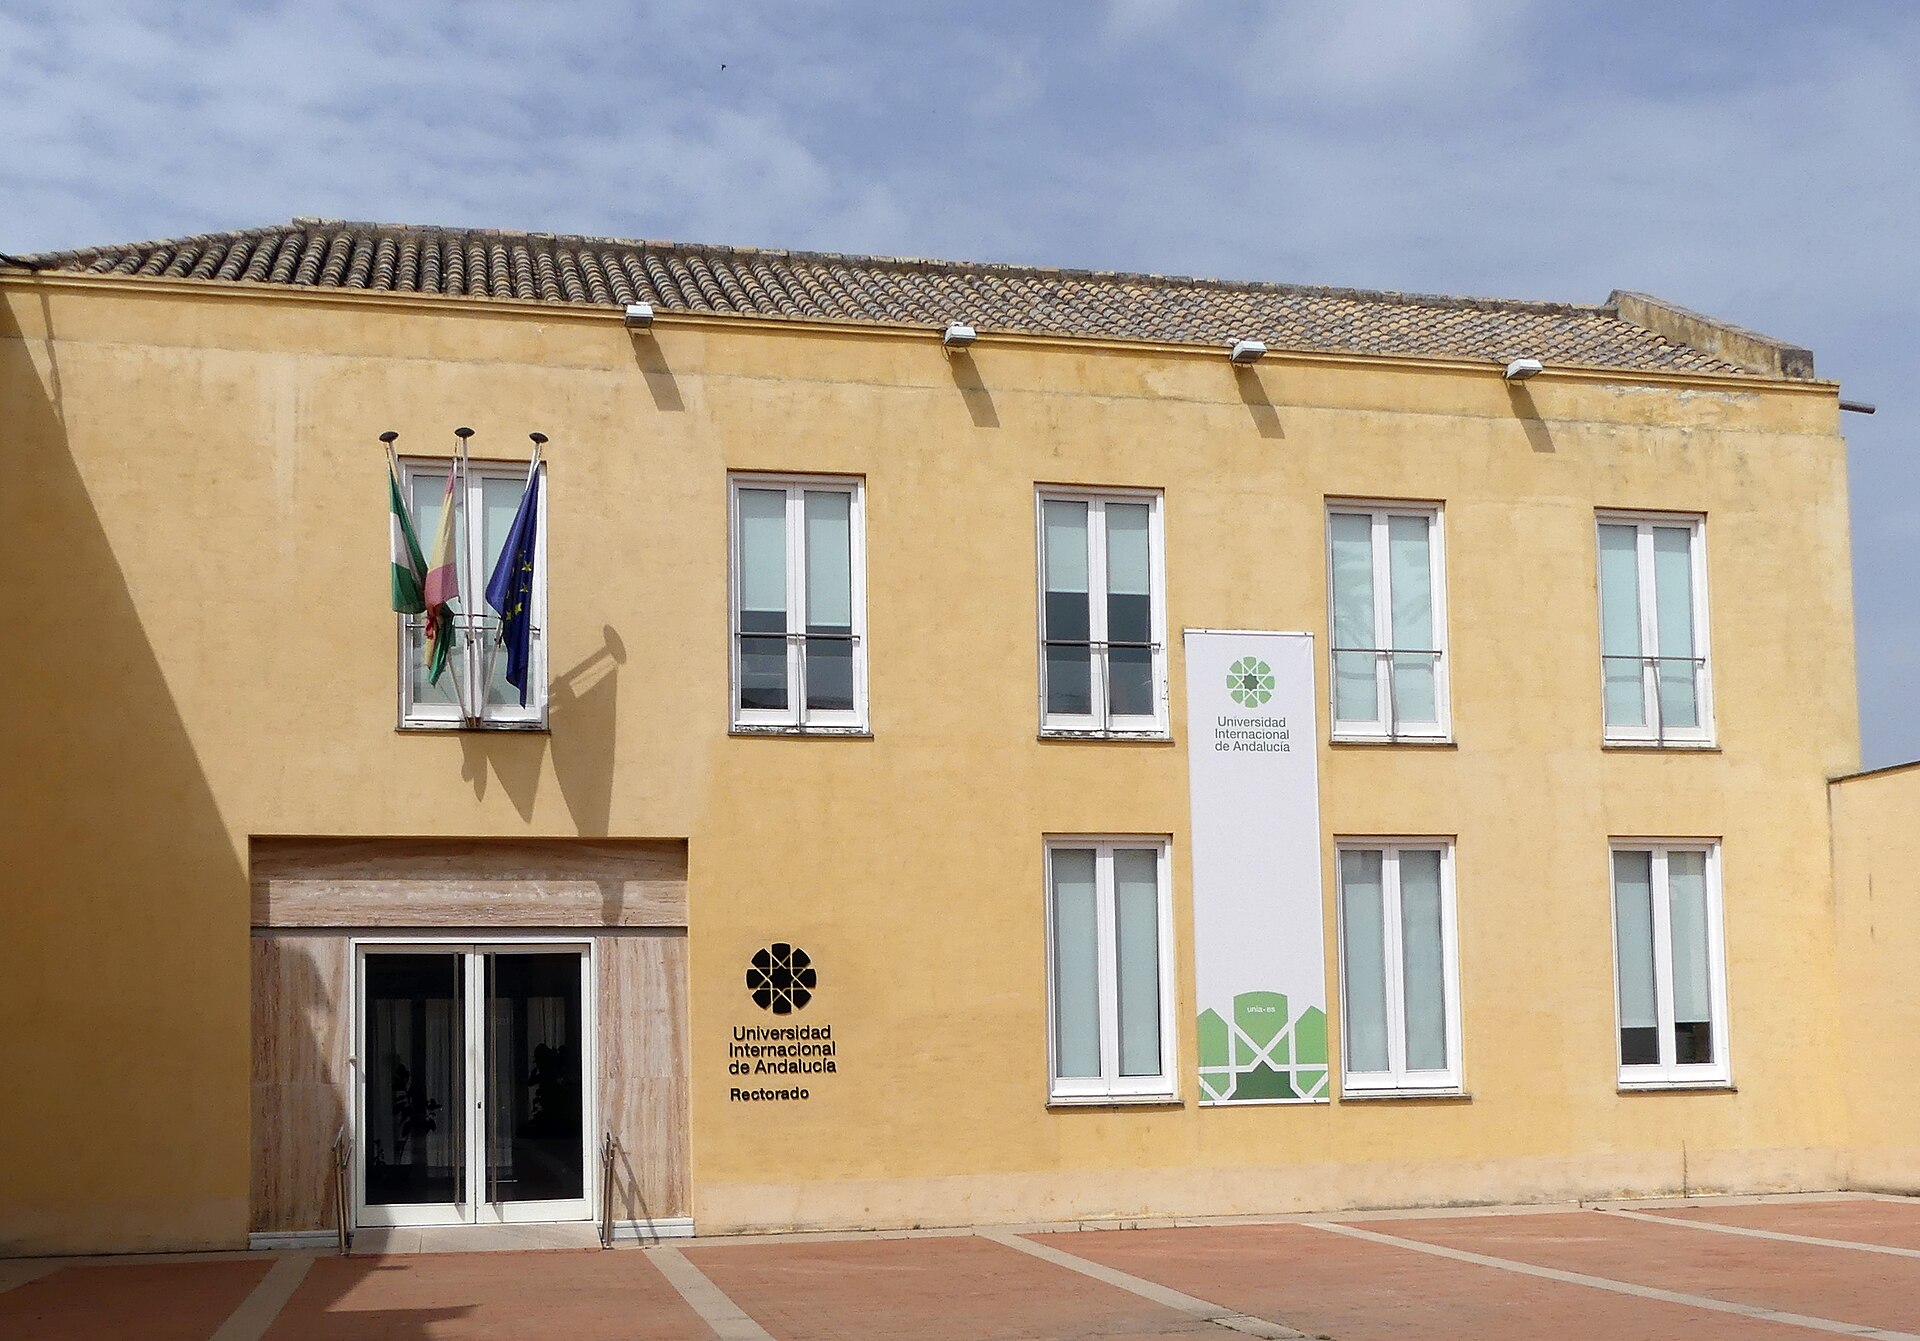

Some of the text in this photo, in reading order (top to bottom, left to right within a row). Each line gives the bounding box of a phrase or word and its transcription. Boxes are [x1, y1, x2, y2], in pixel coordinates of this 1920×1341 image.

[1217, 716, 1286, 728] Universidad
[1214, 728, 1290, 740] Internacional
[1214, 740, 1291, 752] de Andalucía
[733, 1024, 831, 1041] Universidad
[729, 1040, 836, 1058] Internacional
[728, 1057, 837, 1075] de Andalucía
[730, 1086, 809, 1102] Rectorado
